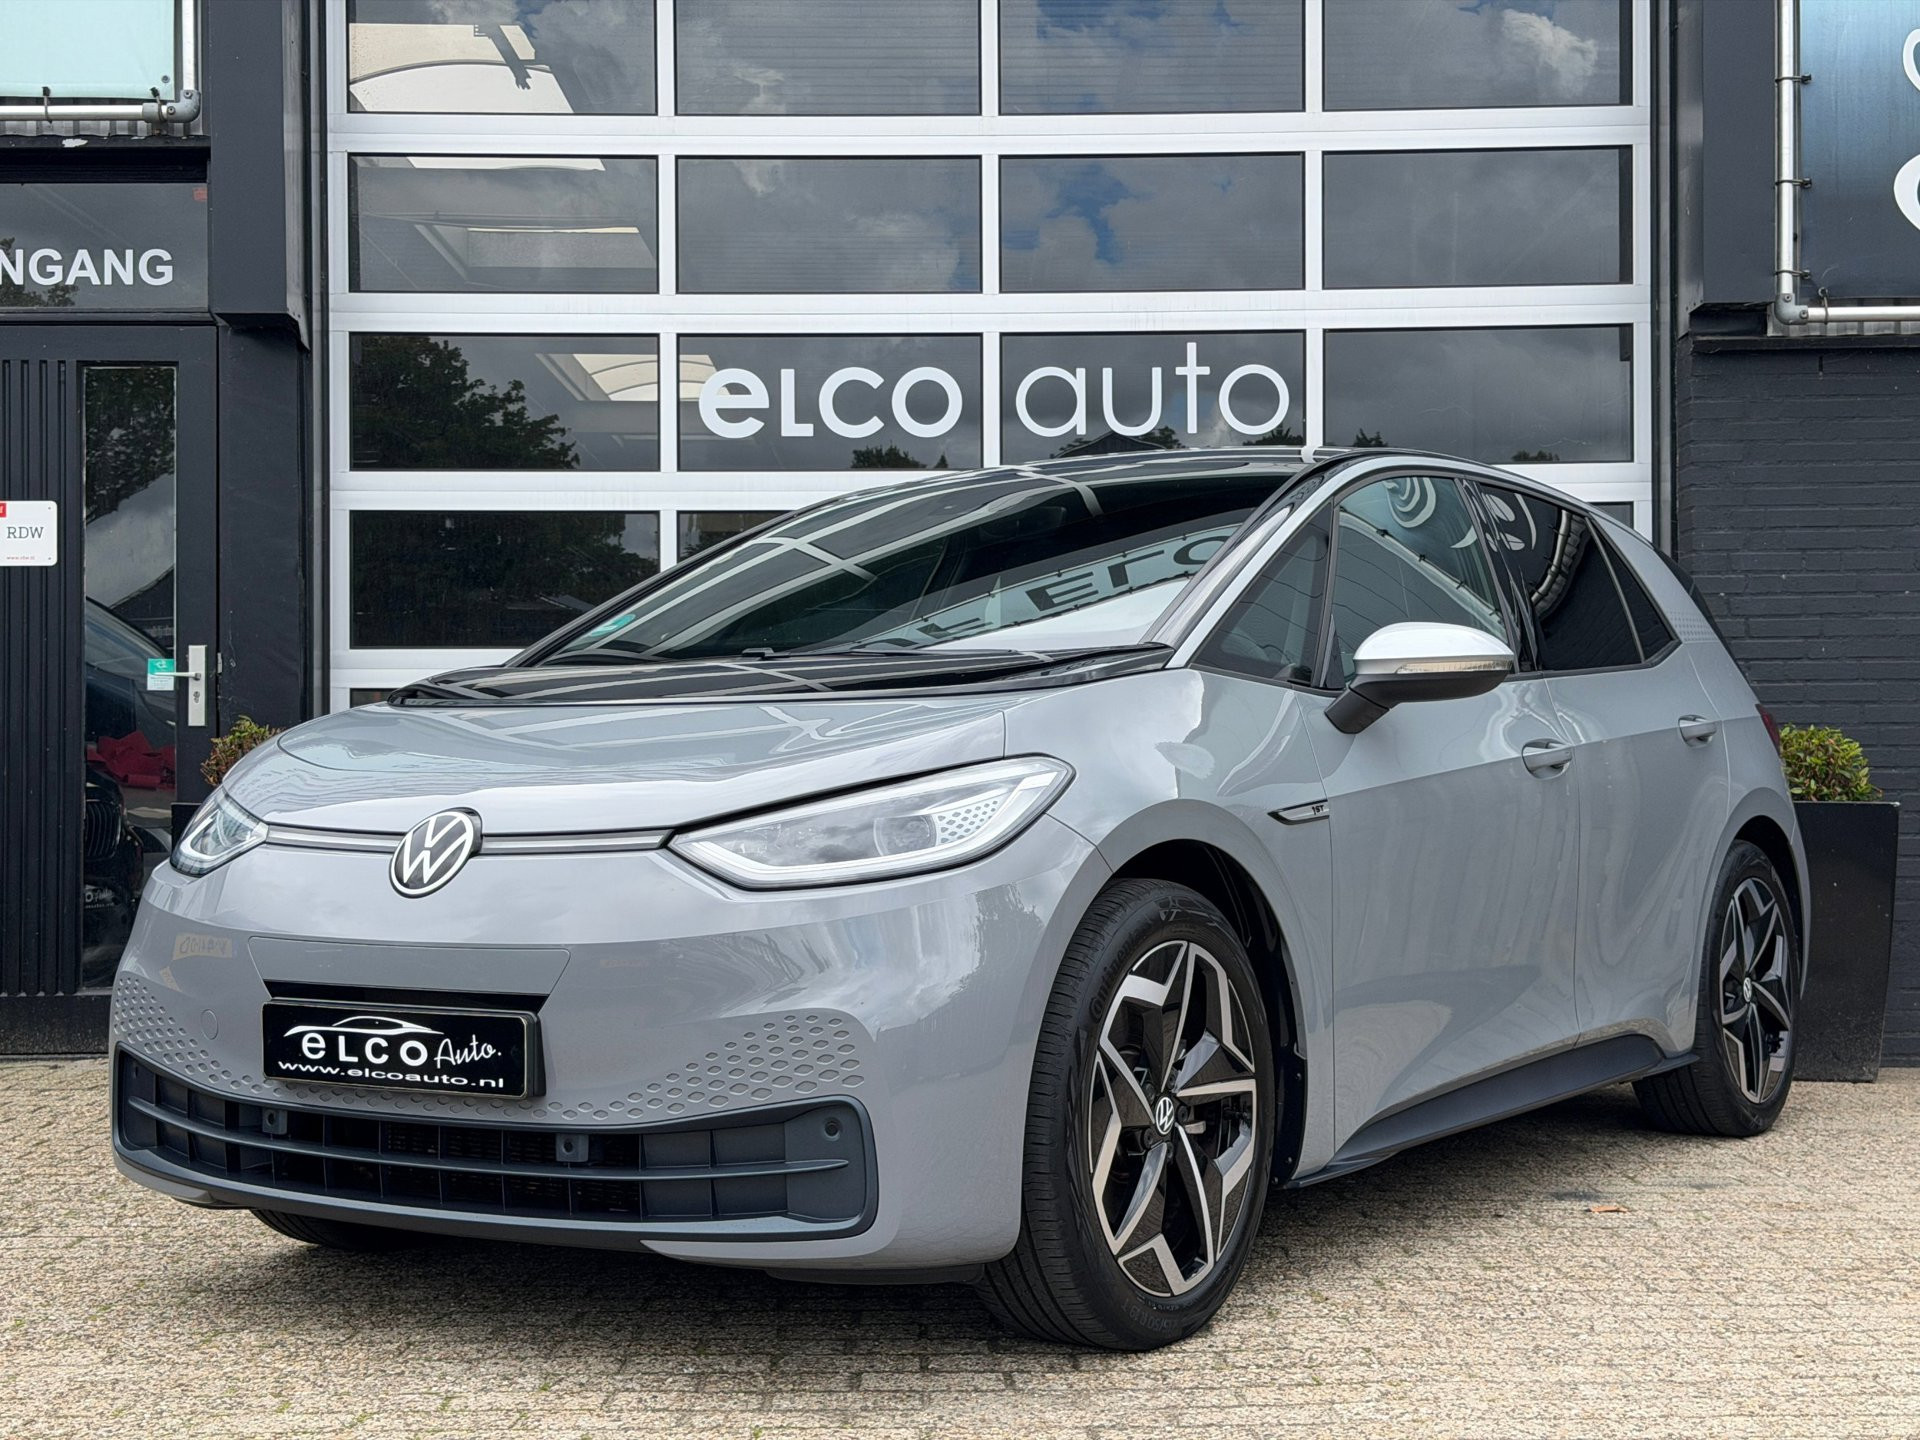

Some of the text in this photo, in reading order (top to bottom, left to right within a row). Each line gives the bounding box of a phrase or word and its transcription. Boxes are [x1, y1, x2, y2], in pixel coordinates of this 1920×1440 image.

[0, 248, 173, 286] NGANG
[1015, 342, 1290, 437] auto
[7, 526, 44, 539] RDW
[278, 1061, 504, 1088] www.elcoauto.nl
